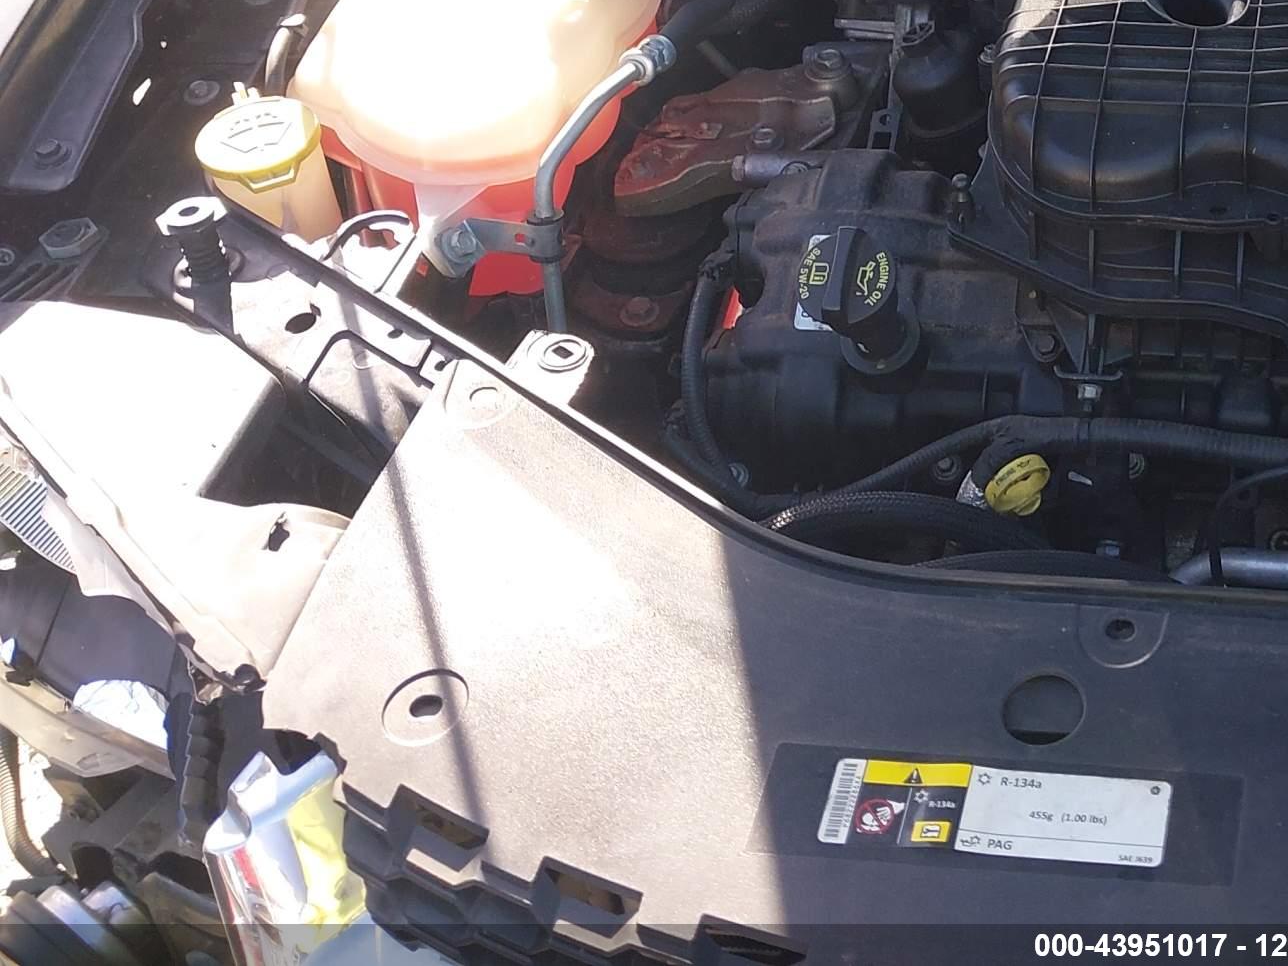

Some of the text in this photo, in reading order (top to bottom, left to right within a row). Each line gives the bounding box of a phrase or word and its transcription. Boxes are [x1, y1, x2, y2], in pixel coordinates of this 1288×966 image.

[799, 247, 821, 299] SAE 5W-20
[864, 252, 889, 306] ENGINE OIL
[1000, 776, 1042, 789] R-134a
[928, 800, 956, 809] R-134a
[1029, 811, 1108, 826] 455g (1.00 lbs)
[987, 838, 1013, 851] PAG
